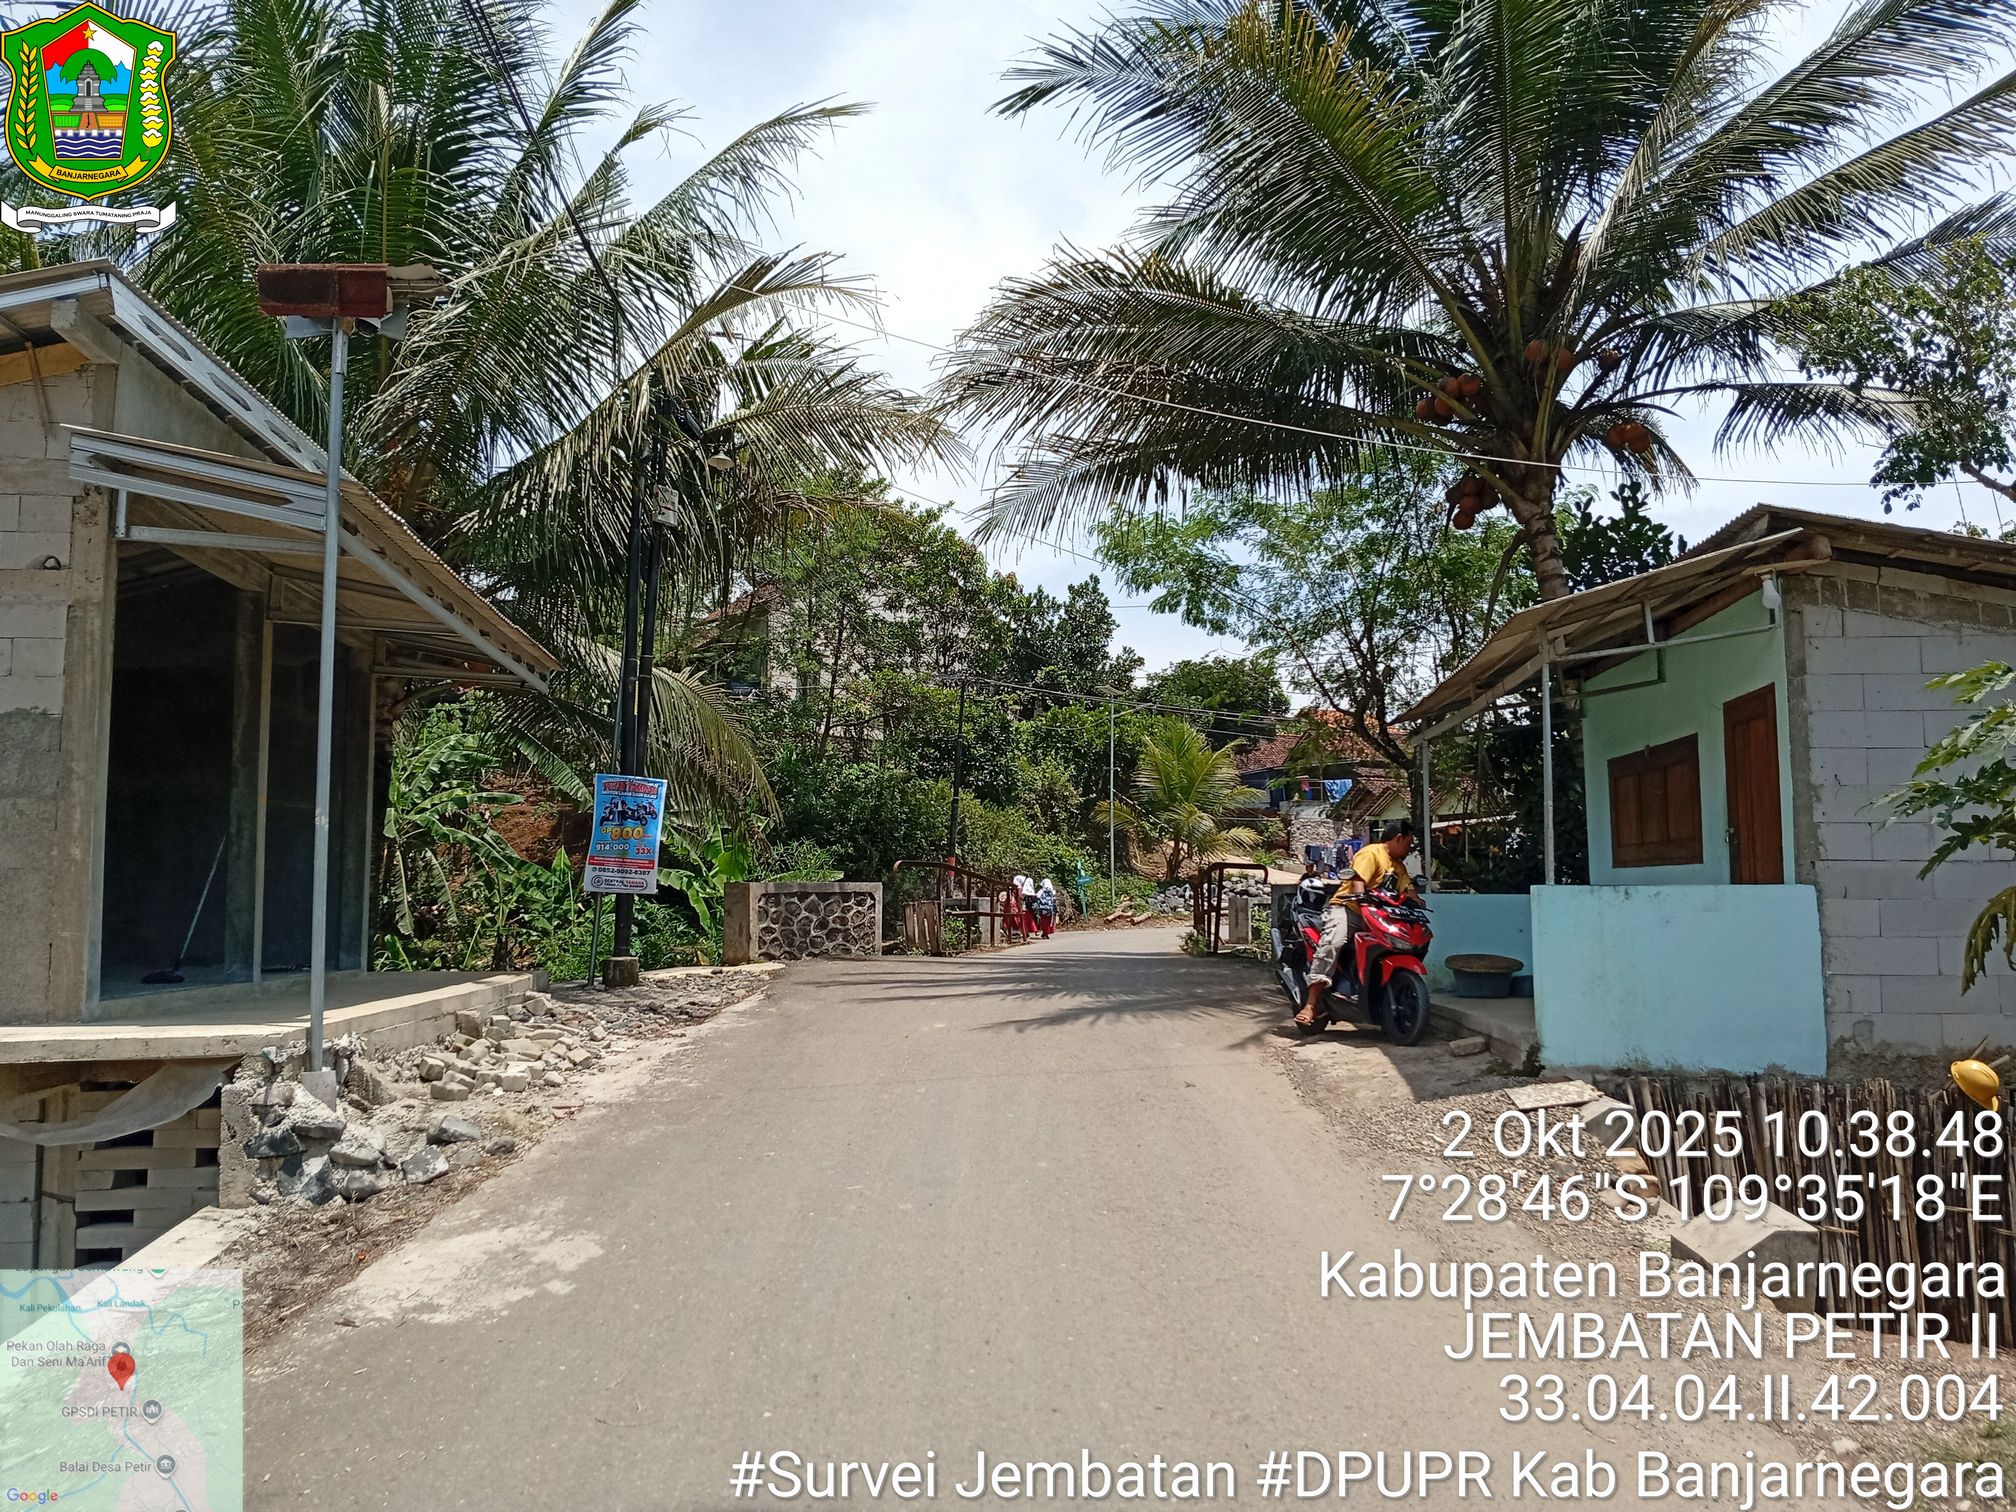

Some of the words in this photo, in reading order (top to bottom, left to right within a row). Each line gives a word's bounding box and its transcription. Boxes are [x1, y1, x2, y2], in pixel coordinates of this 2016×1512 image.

[610, 825, 644, 840] 800
[595, 843, 630, 852] 914.000
[635, 847, 653, 855] 33X
